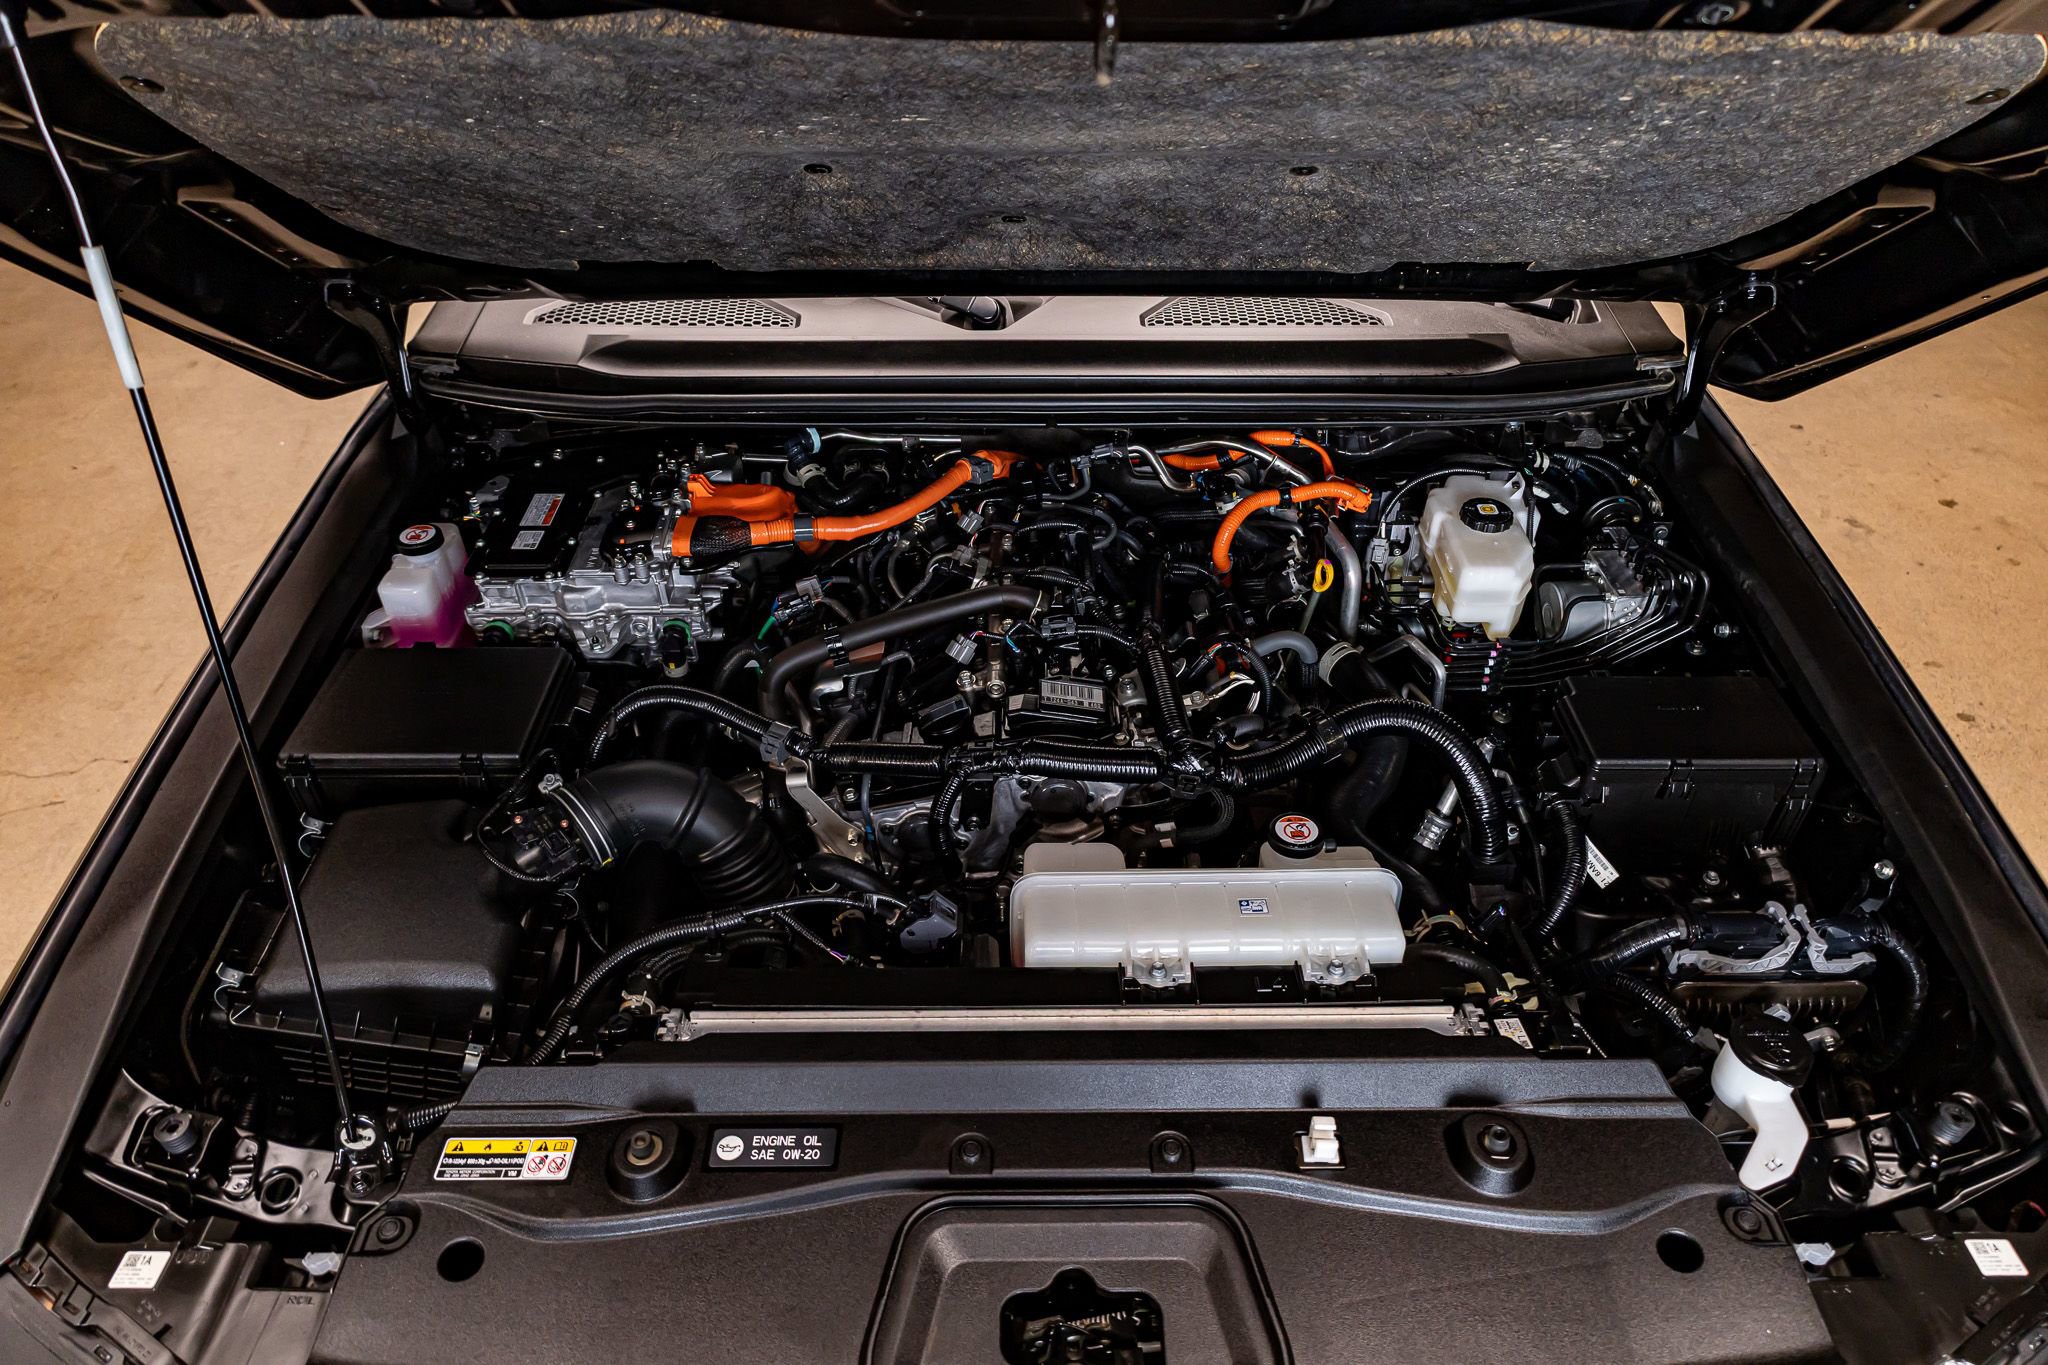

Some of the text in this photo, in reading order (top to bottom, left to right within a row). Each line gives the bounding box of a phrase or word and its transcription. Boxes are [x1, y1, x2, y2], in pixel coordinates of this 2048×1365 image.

[752, 1135, 822, 1146] ENGINE OIL
[750, 1148, 820, 1160] SAE 0W-20
[141, 1255, 153, 1266] 1A
